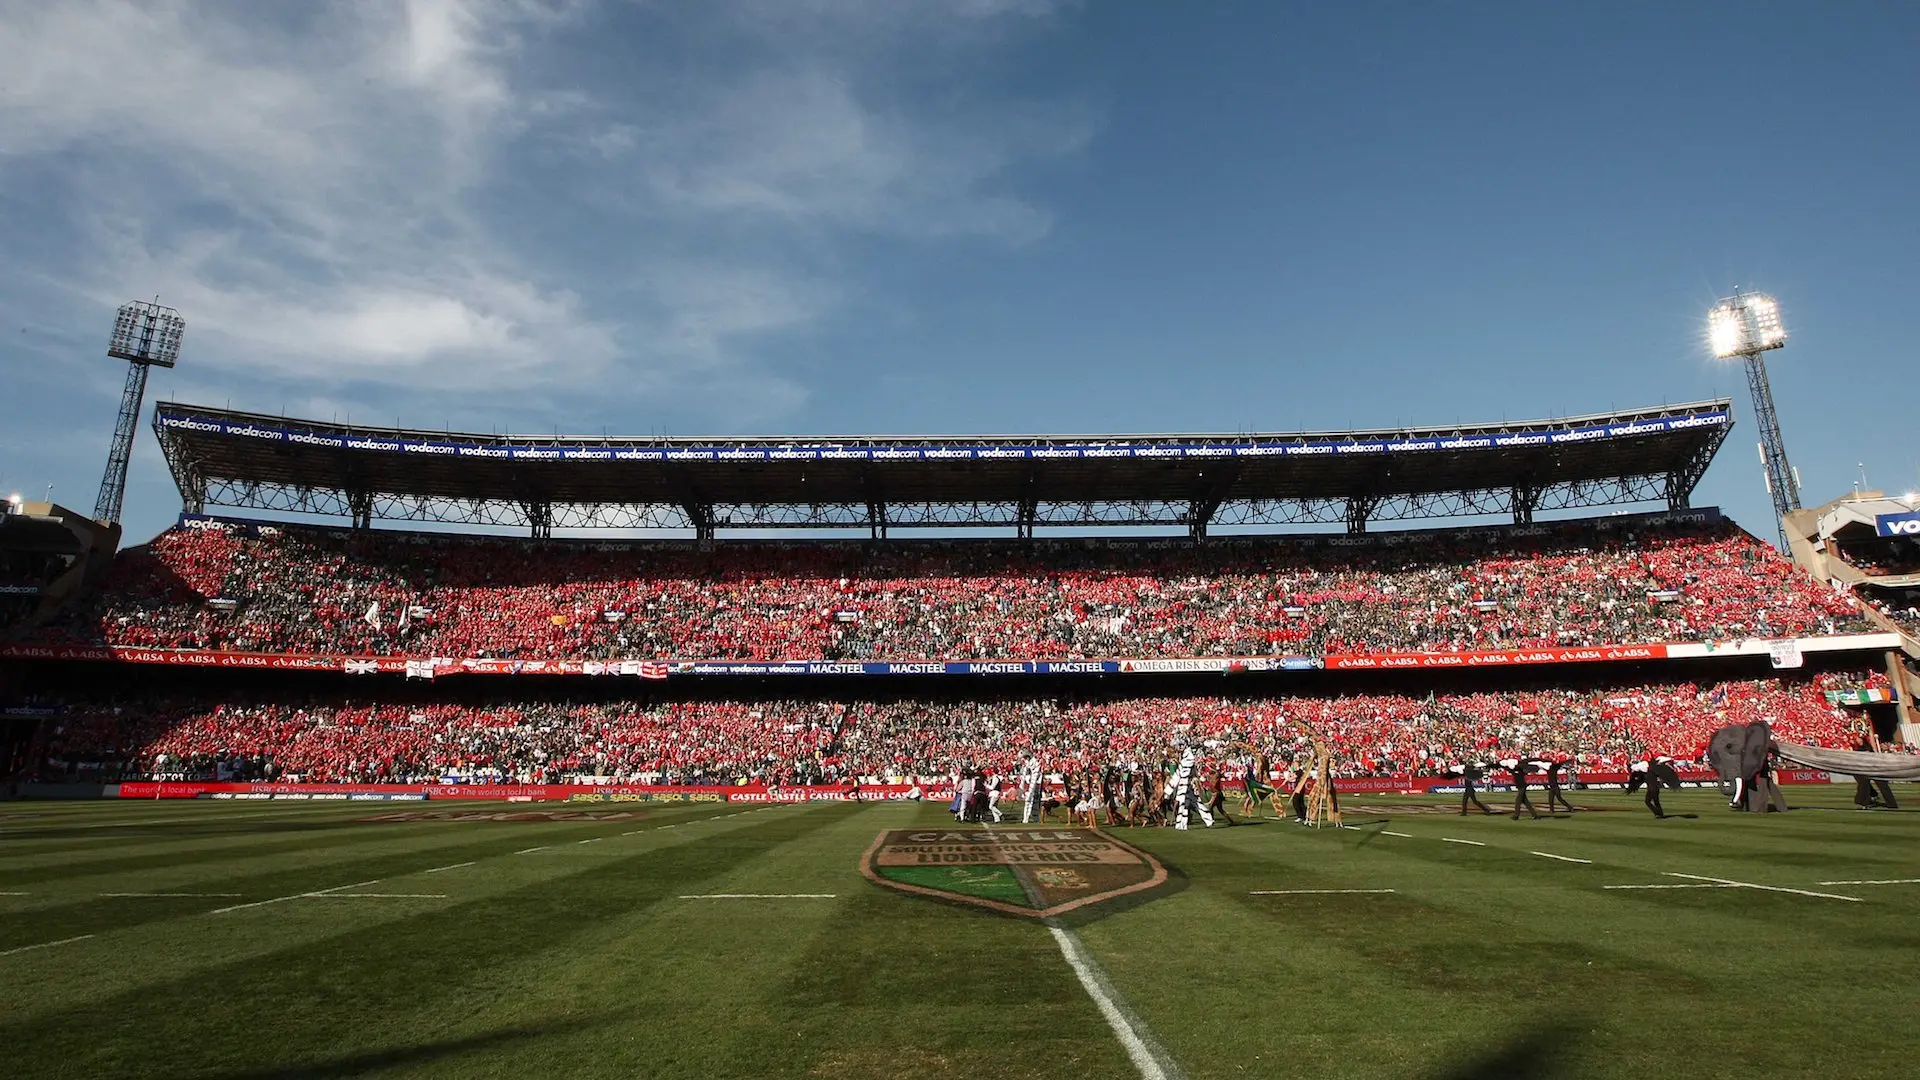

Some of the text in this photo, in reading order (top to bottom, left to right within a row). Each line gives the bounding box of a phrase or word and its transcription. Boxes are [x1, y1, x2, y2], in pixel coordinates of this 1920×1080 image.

[162, 413, 1726, 460] vodacom vodacom vodacom vodacom vodacom vodacom vodacom vodacom vodacom vodacom vodacom vodacom vodacom vodacom vodacom vodacom vodacom vodacom vodacom vodacom vodacom vodacom vodacom vodacom vodacom vodacom vodacom vodacom vodacom
[134, 652, 165, 662] ABSA
[187, 655, 216, 664] ABSA
[239, 656, 268, 666] ABSA
[475, 663, 499, 671] ABSA
[1352, 648, 1651, 666] ABSA ABSA ABSA ABSA ABSA ABSA ABSA
[729, 663, 767, 673] vodacom
[768, 663, 806, 673] vodacom
[809, 662, 1105, 674] MACSTEEL MACSTEEL MACSTEEL MACSTEEL
[1134, 660, 1175, 671] OMEGA
[1176, 660, 1201, 671] RISK
[1793, 773, 1816, 781] HSBC
[123, 785, 138, 793] The
[168, 785, 186, 793] local
[1344, 781, 1373, 789] world's
[1374, 781, 1392, 789] local
[1394, 781, 1410, 789] ban
[421, 787, 446, 795] HSBC
[461, 787, 476, 796] The
[478, 787, 505, 796] world's
[527, 787, 547, 796] bank
[731, 793, 767, 801] CASTLE
[907, 831, 1082, 843] CASTLE
[918, 852, 1101, 863] LIONS SERIES
